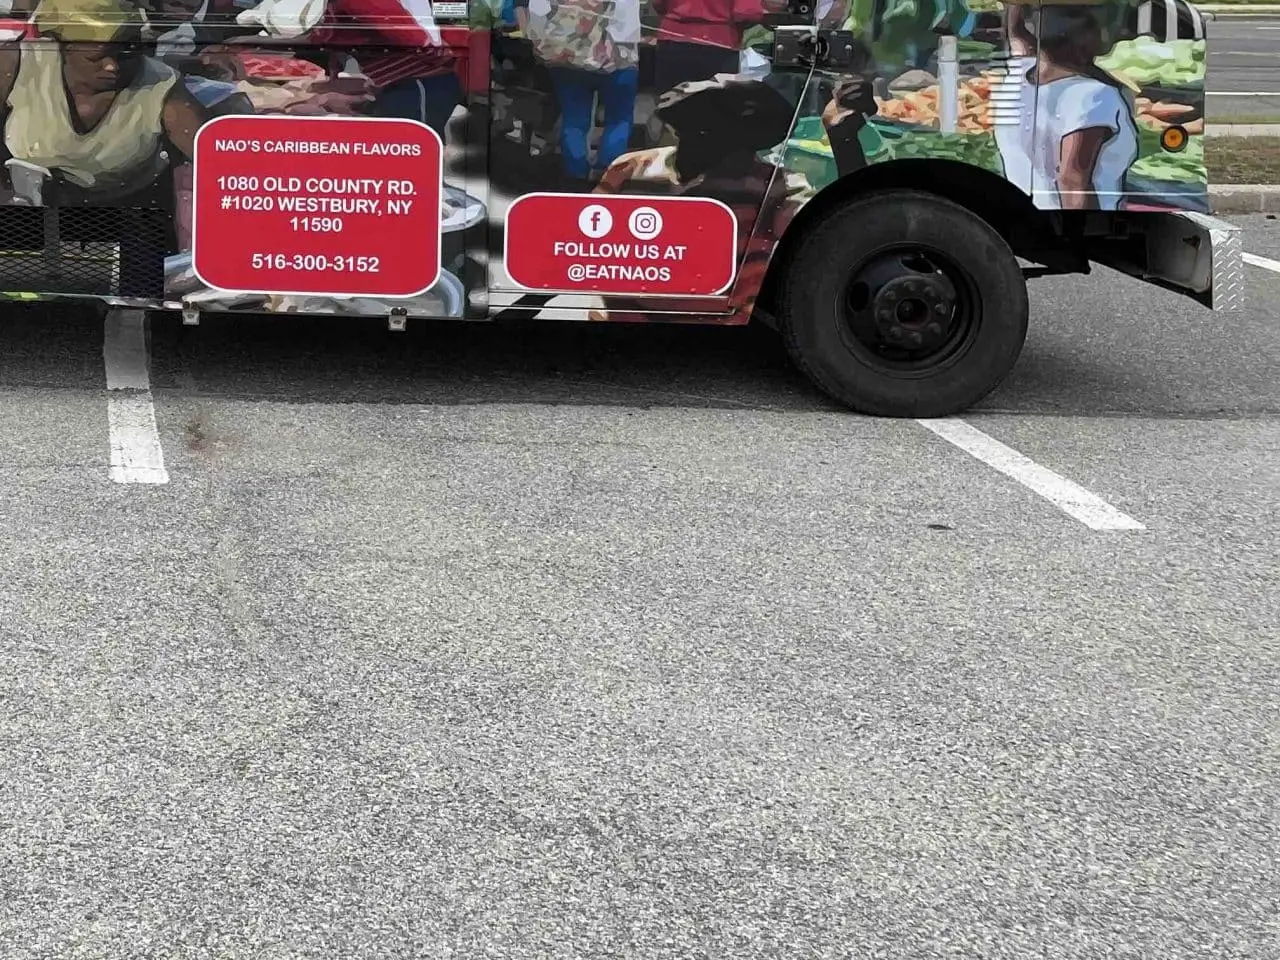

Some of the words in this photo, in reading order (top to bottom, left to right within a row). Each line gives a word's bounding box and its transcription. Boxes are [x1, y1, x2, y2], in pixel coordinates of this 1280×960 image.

[215, 140, 260, 153] NAO'S
[264, 141, 350, 155] CARIBBEAN
[353, 143, 421, 157] FLAVORS
[217, 176, 259, 191] 1080
[263, 177, 301, 192] OLD
[306, 178, 383, 194] COUNTY
[388, 180, 417, 196] RD.
[221, 196, 274, 211] #1020
[277, 197, 382, 216] WESTBURY,
[387, 200, 412, 215] NY
[290, 217, 343, 232] 11590
[554, 242, 630, 258] FOLLOW
[634, 244, 659, 259] US
[664, 245, 687, 260] AT
[252, 253, 380, 272] 516-300-3152
[568, 264, 671, 282] @EATNAOS
